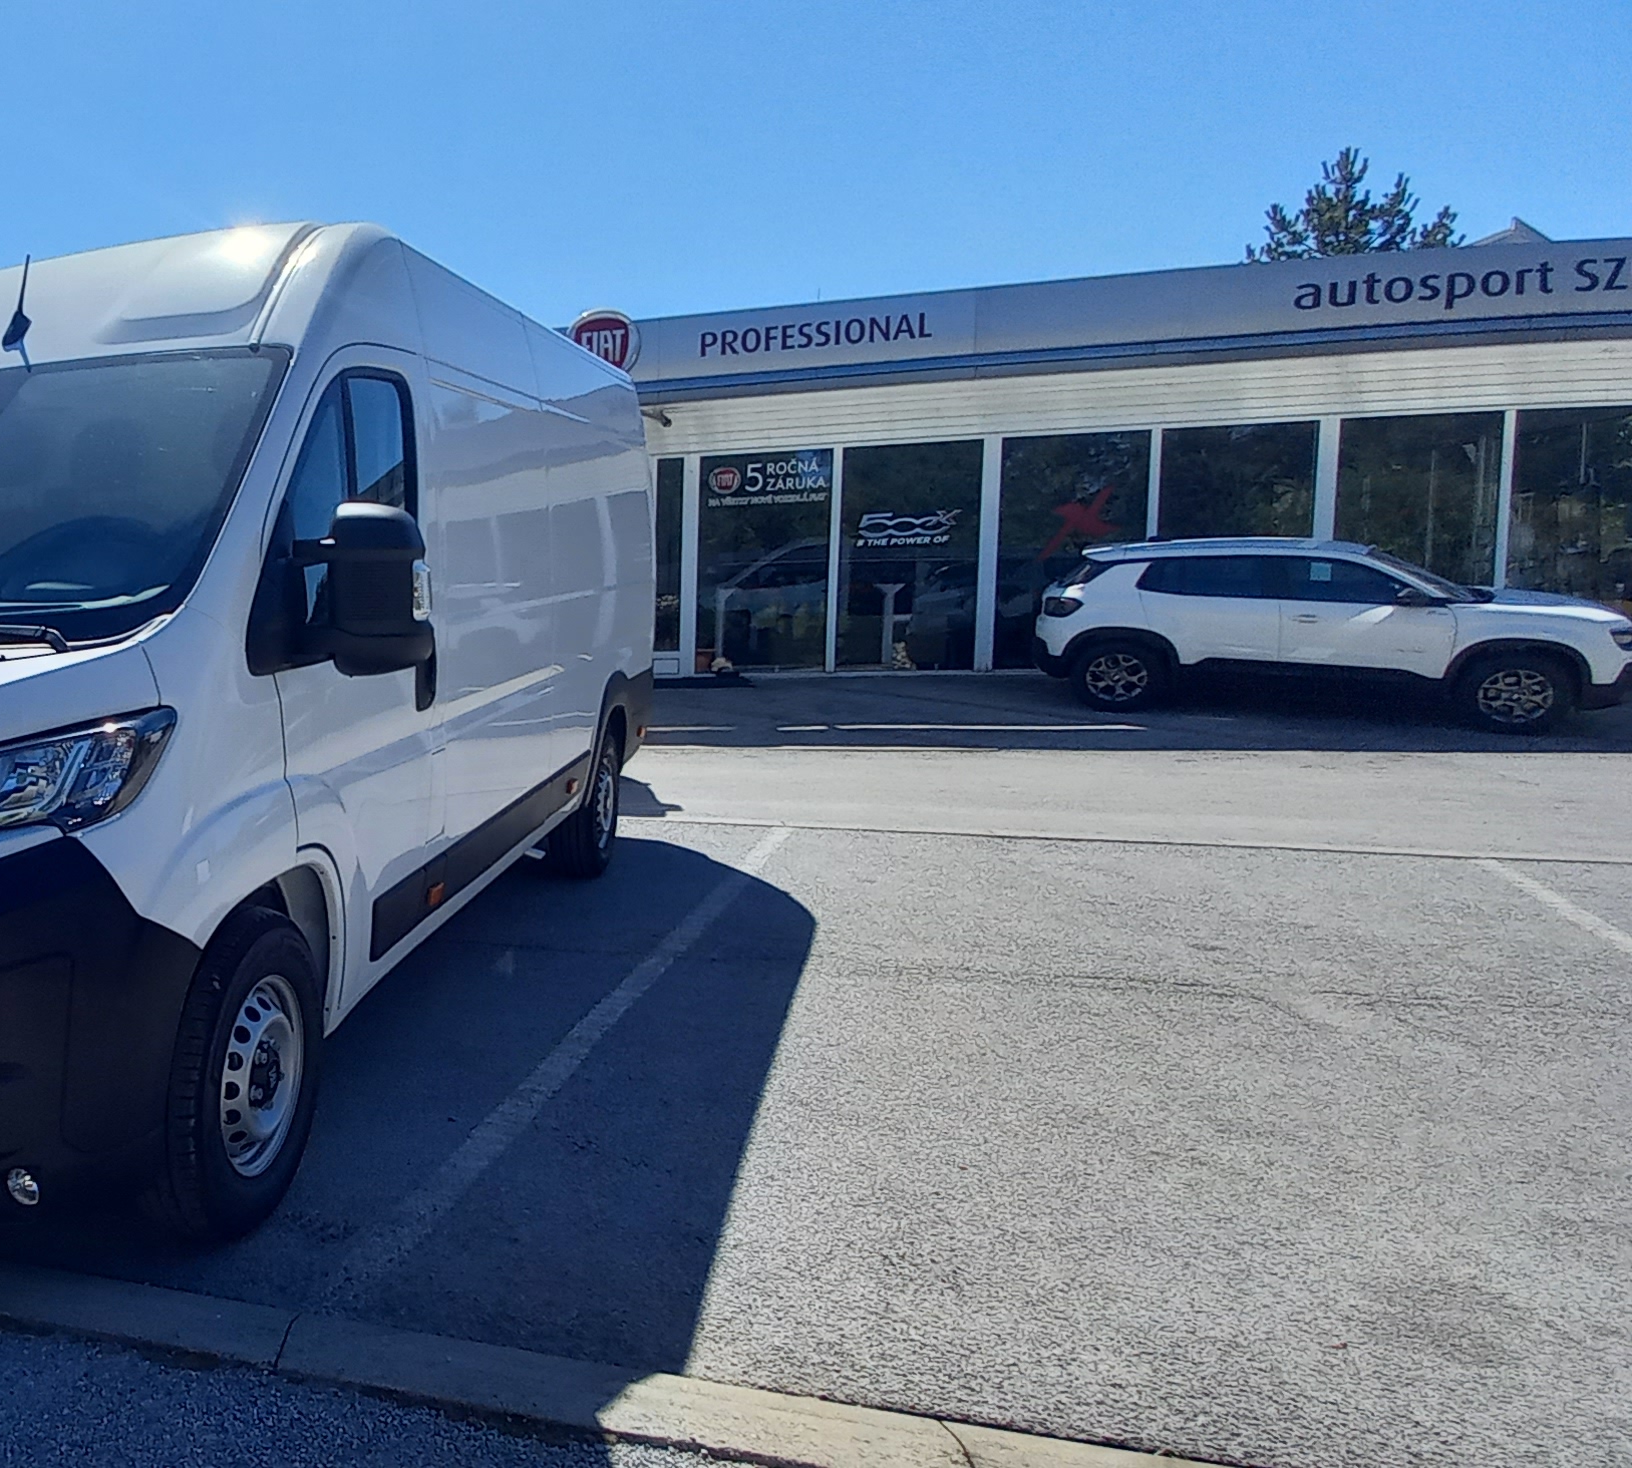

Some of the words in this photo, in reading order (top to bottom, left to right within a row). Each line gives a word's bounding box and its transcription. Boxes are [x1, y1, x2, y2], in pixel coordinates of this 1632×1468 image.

[1293, 261, 1554, 311] autosport
[1574, 256, 1628, 291] SZ
[581, 329, 626, 362] FIAT
[700, 312, 932, 357] PROFESSIONAL
[744, 463, 763, 492] 5
[766, 457, 819, 476] ROČNÁ
[868, 538, 888, 547] THE
[889, 536, 931, 546] POWER
[933, 534, 950, 544] OF
